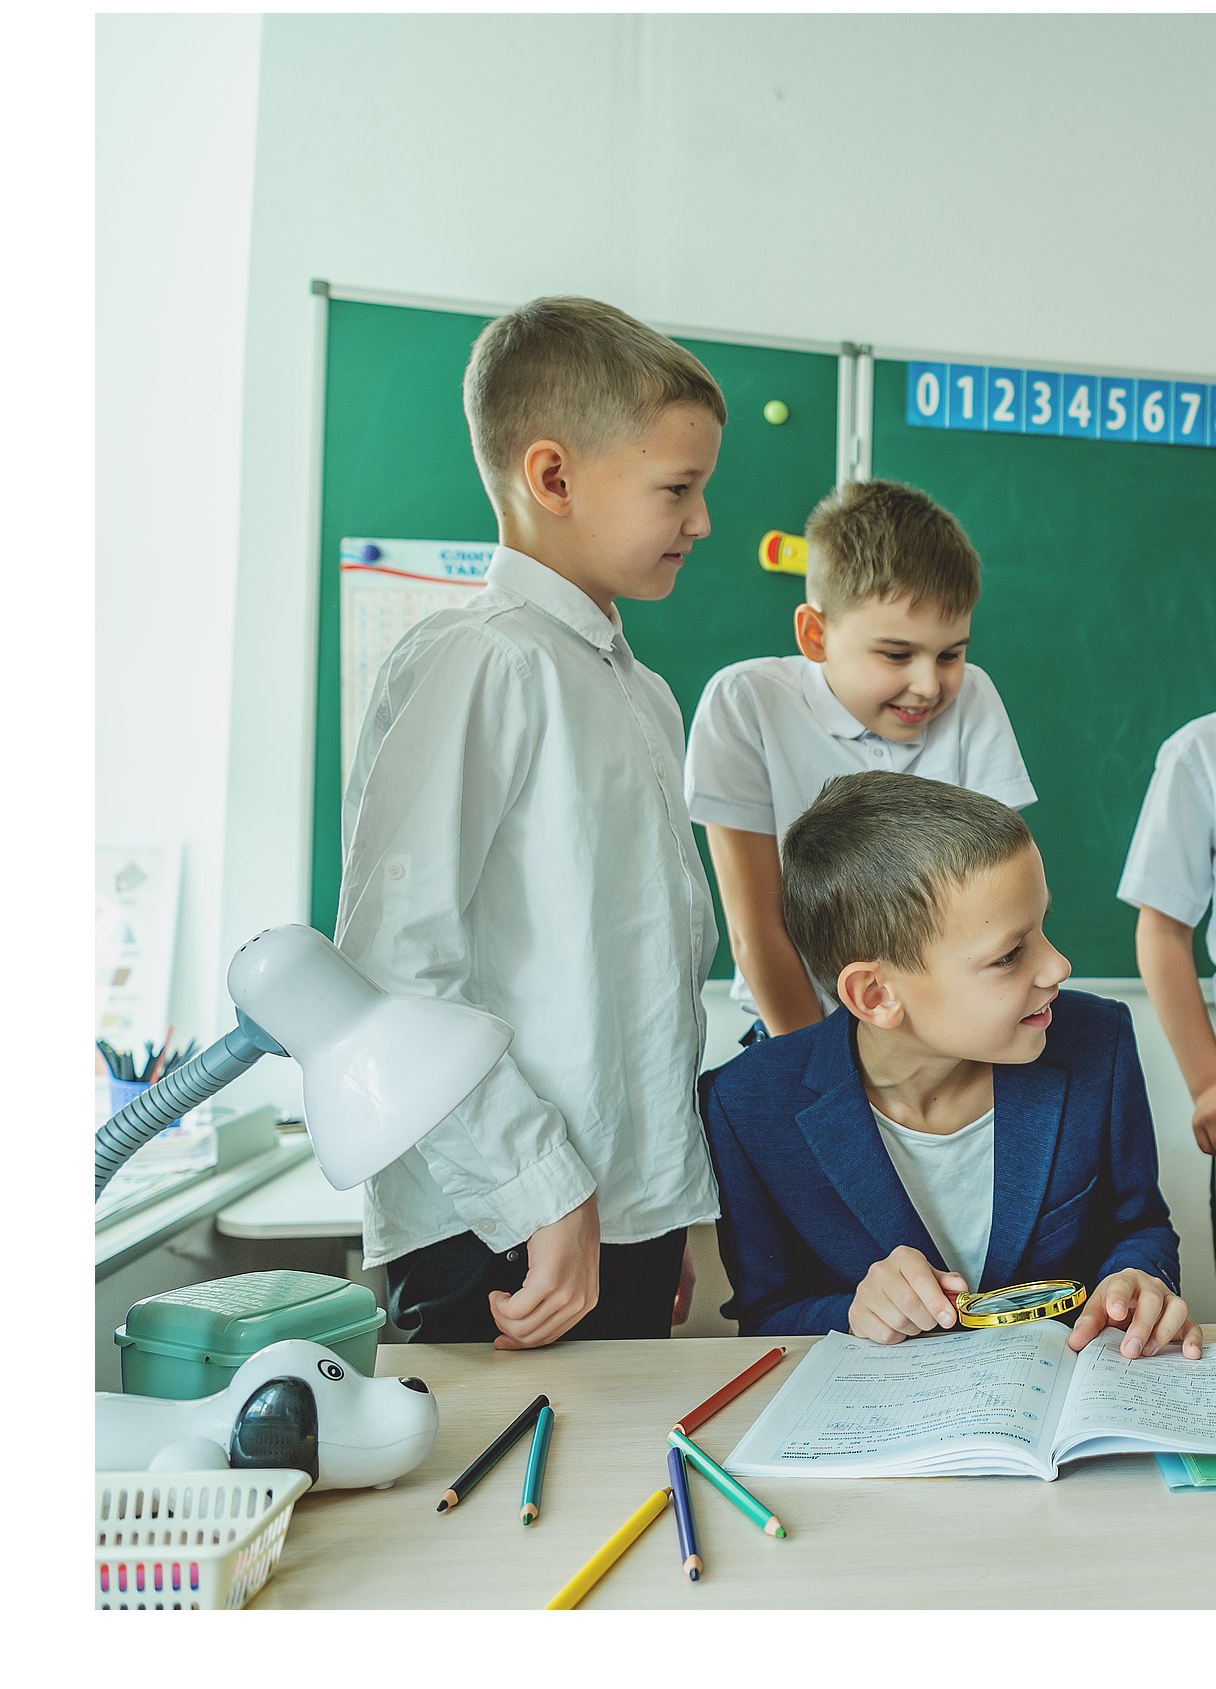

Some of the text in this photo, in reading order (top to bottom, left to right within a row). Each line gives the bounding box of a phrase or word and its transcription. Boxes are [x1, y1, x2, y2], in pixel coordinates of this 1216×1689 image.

[916, 372, 940, 416] 0
[957, 376, 973, 419] 1
[993, 379, 1015, 421] 2
[1032, 382, 1052, 425] 3
[1068, 385, 1091, 428] 4
[1106, 388, 1126, 430] 5
[1142, 391, 1165, 433] 6
[1180, 393, 1201, 435] 7
